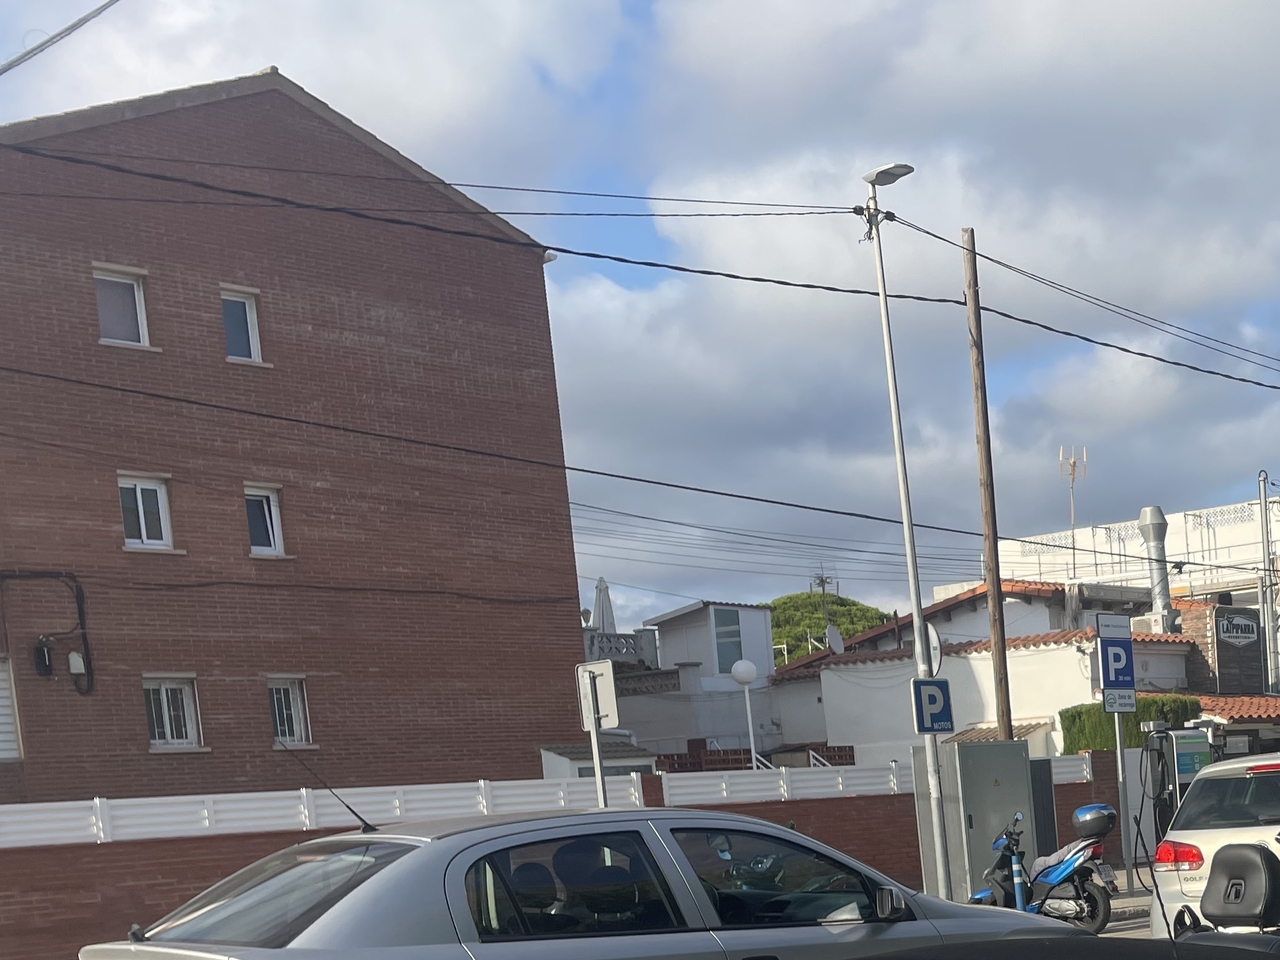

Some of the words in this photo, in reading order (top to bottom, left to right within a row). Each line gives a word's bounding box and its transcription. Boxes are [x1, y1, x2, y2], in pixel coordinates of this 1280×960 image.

[1107, 646, 1127, 681] P
[921, 685, 944, 728] P
[933, 721, 952, 730] MOTOS
